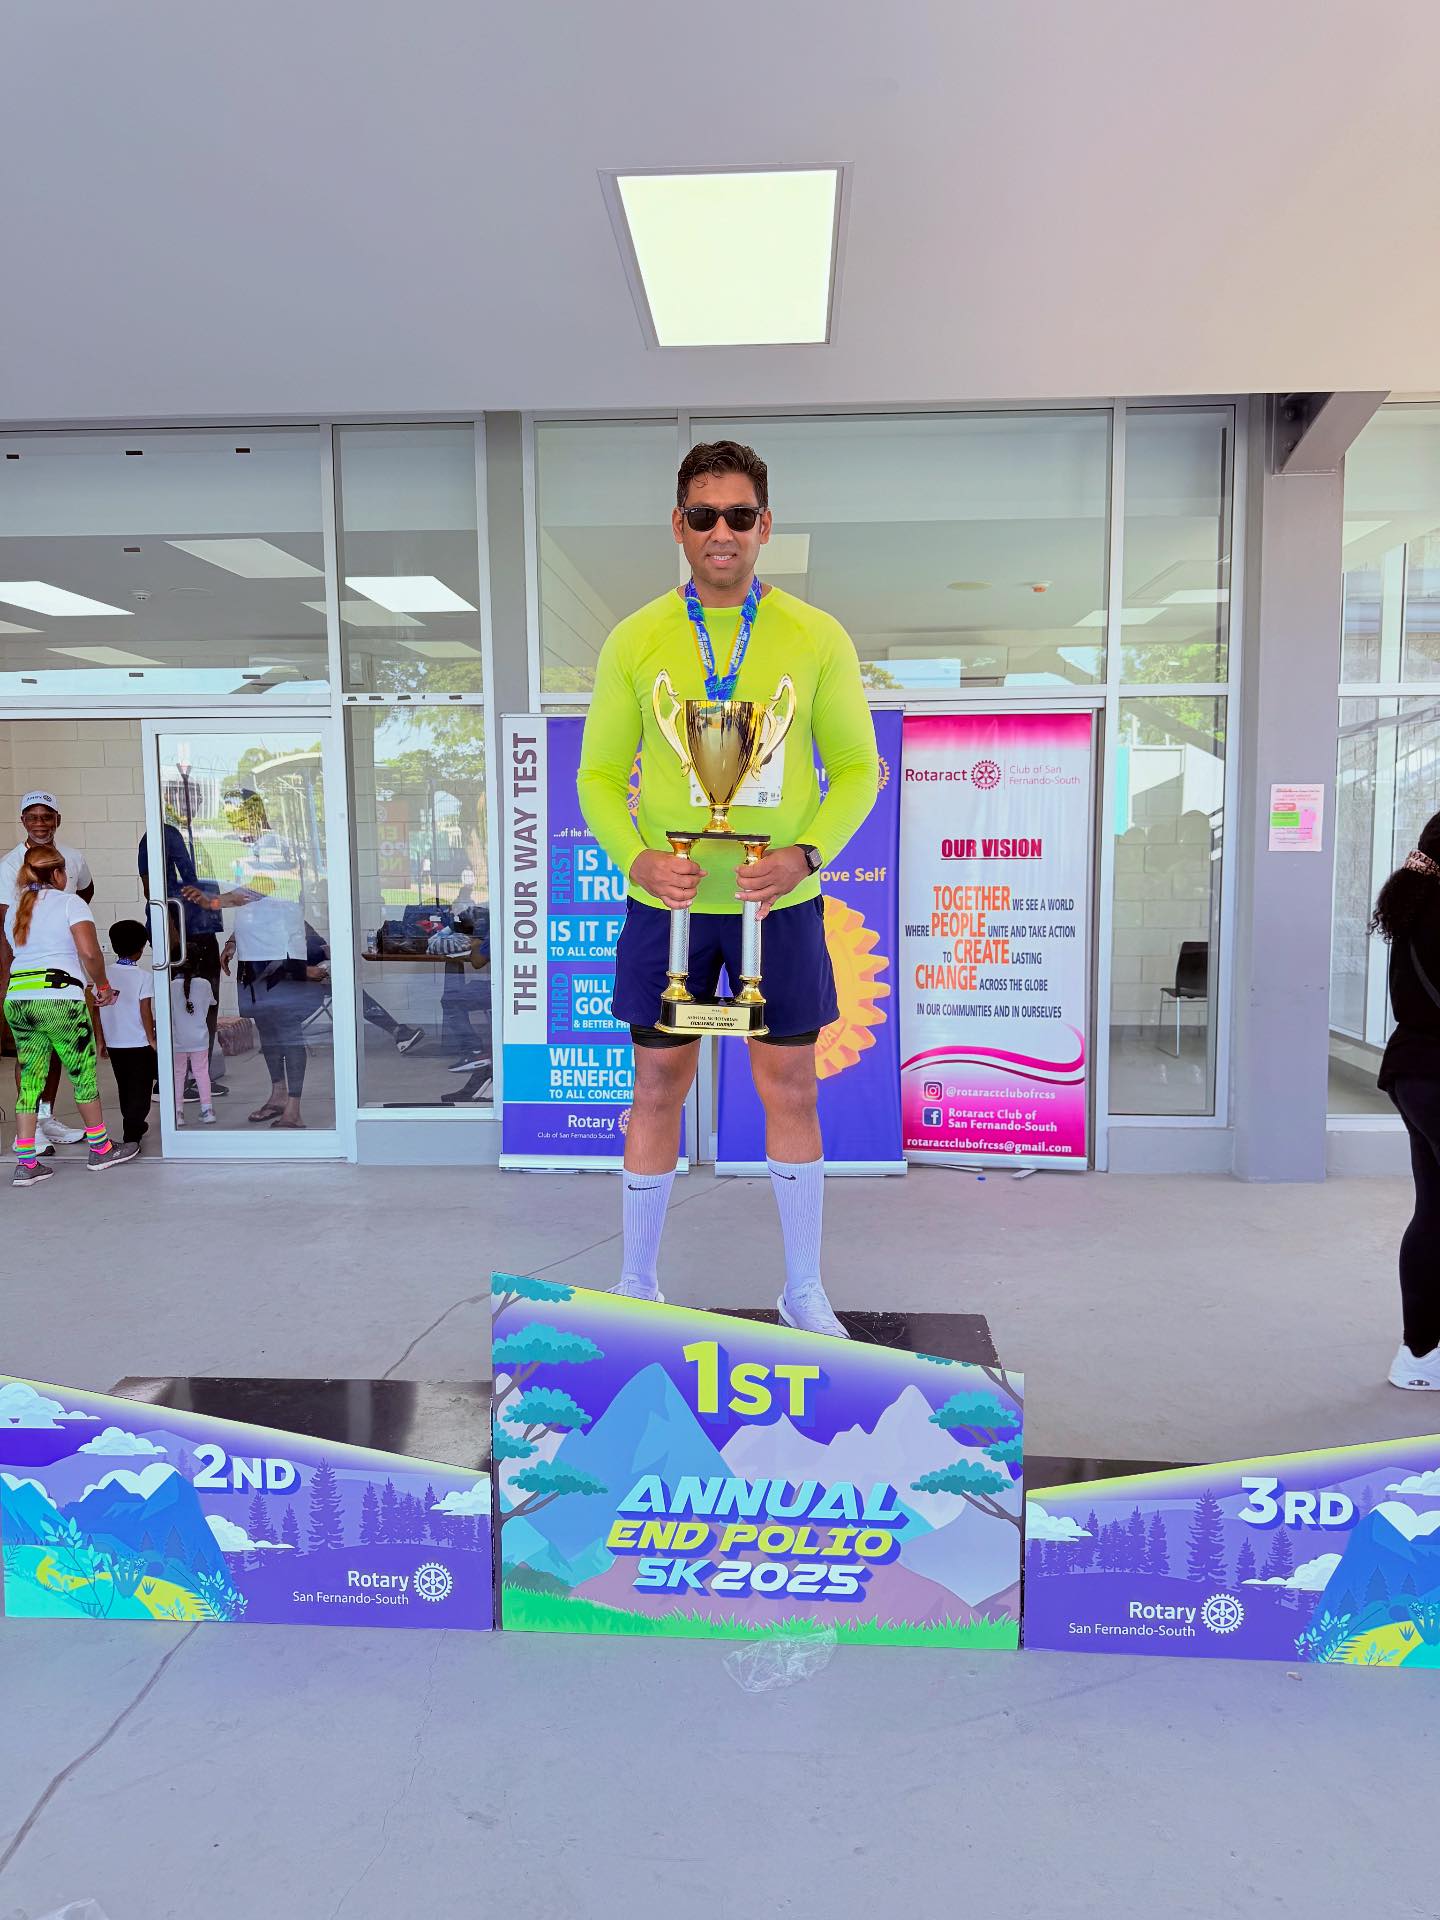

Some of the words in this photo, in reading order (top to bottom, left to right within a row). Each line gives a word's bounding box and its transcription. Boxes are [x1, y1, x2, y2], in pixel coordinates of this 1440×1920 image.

[513, 733, 538, 797] TEST
[905, 768, 968, 782] Rotaract
[1009, 765, 1030, 775] Club
[1033, 765, 1043, 775] of
[1045, 765, 1062, 775] San
[1009, 776, 1081, 785] Fernando-South
[513, 807, 538, 871] WAY
[570, 828, 582, 838] the
[941, 839, 977, 857] OUR
[982, 839, 1042, 857] VISION
[578, 849, 599, 871] IS
[552, 845, 570, 904] FIRST
[820, 871, 851, 882] ove
[855, 867, 887, 882] Self
[578, 876, 628, 901] TRU
[933, 885, 1011, 911] TOGETHER
[1012, 899, 1024, 911] WE
[1025, 899, 1038, 911] SEE
[1040, 899, 1046, 911] A
[1048, 899, 1074, 911] WORLD
[513, 881, 538, 954] FOUR
[905, 924, 930, 937] WHERE
[931, 912, 986, 937] PEOPLE
[988, 925, 1009, 938] UNITE
[1010, 925, 1026, 938] AND
[1028, 926, 1047, 938] TAKE
[1048, 926, 1076, 938] ACTION
[551, 920, 571, 942] IS
[580, 921, 599, 942] IT
[550, 946, 565, 957] TO
[567, 946, 587, 957] ALL
[589, 946, 618, 957] CONC
[943, 951, 952, 963] TO
[954, 939, 1010, 964] CREATE
[1011, 952, 1042, 965] LASTING
[573, 979, 611, 994] WILL
[915, 964, 977, 990] CHANGE
[979, 978, 1008, 991] ACROSS
[1009, 979, 1023, 991] THE
[1024, 979, 1048, 992] GLOBE
[513, 964, 537, 1015] THE
[552, 972, 569, 1034] THIRD
[917, 1003, 925, 1015] IN
[926, 1003, 941, 1016] OUR
[942, 1003, 992, 1017] COMMUNITIES
[994, 1005, 1010, 1017] AND
[1012, 1005, 1020, 1018] IN
[1021, 1005, 1062, 1018] OURSELVES
[573, 1019, 581, 1029] &
[582, 1019, 614, 1029] BETTER
[549, 1047, 600, 1067] WILL
[606, 1048, 625, 1067] IT
[550, 1069, 633, 1088] BENEFICI
[549, 1089, 563, 1099] TO
[566, 1089, 585, 1099] ALL
[946, 1086, 1056, 1100] @rotaractclubofrcss
[568, 1114, 616, 1132] Rotary
[948, 1107, 995, 1119] Rotaract
[997, 1109, 1022, 1120] Club
[1025, 1110, 1037, 1120] of
[948, 1119, 968, 1129] San
[970, 1120, 1058, 1133] Fernando-South
[906, 1138, 1072, 1153] rotaractclubofrcss@gmail.com
[682, 1341, 822, 1418] 1ST
[193, 1444, 298, 1491] 2ND
[615, 1474, 904, 1525] ANNUAL
[1237, 1476, 1355, 1526] 3RD
[605, 1519, 711, 1551] END
[718, 1523, 895, 1559] POLIO
[347, 1570, 409, 1592] Rotary
[631, 1557, 711, 1590] 5K
[710, 1560, 867, 1596] 2025
[292, 1591, 314, 1602] San
[316, 1592, 409, 1605] Fernando-South
[1129, 1601, 1197, 1623] Rotary
[1068, 1623, 1092, 1634] San
[1094, 1623, 1196, 1637] Fernando-South
